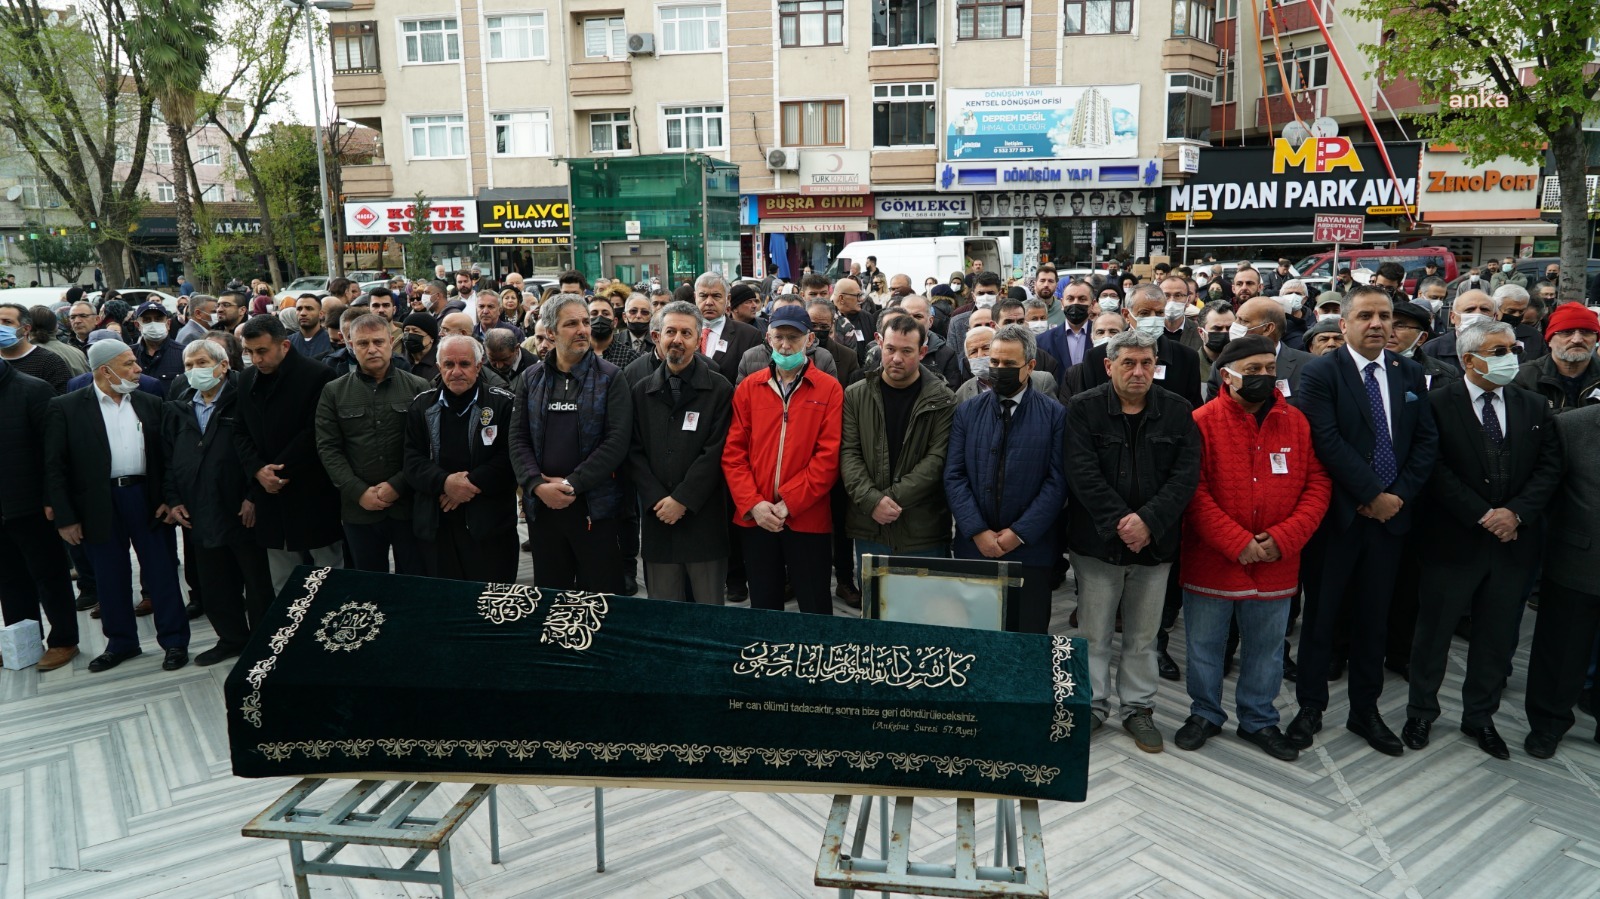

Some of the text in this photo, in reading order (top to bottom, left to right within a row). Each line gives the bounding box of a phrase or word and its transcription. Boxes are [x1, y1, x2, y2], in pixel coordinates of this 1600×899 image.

[985, 90, 1023, 98] DÖNÜŞÜM
[1001, 98, 1040, 106] DÖNÜŞÜM
[1042, 97, 1062, 105] OFİSİ
[982, 112, 1046, 123] DEPREM DEĞİL
[1003, 167, 1092, 183] DÖNÜŞÜM YAPI
[1170, 181, 1278, 211] MEYDAN
[1285, 179, 1357, 208] PARK
[1359, 177, 1416, 206] AVM
[387, 203, 465, 219] KÖFTE
[493, 201, 569, 220] PİLAVCI
[766, 195, 815, 212] BÜŞRA
[881, 198, 966, 213] GÖMLEKÇİ
[388, 220, 465, 232] SUUK
[504, 220, 558, 229] CUMA USTA
[729, 699, 744, 709] Her
[746, 701, 761, 710] can
[763, 701, 789, 712] ölümü
[835, 707, 860, 716] sonra
[862, 706, 880, 716] bize
[882, 707, 898, 718] geri
[914, 723, 938, 733] Suresi
